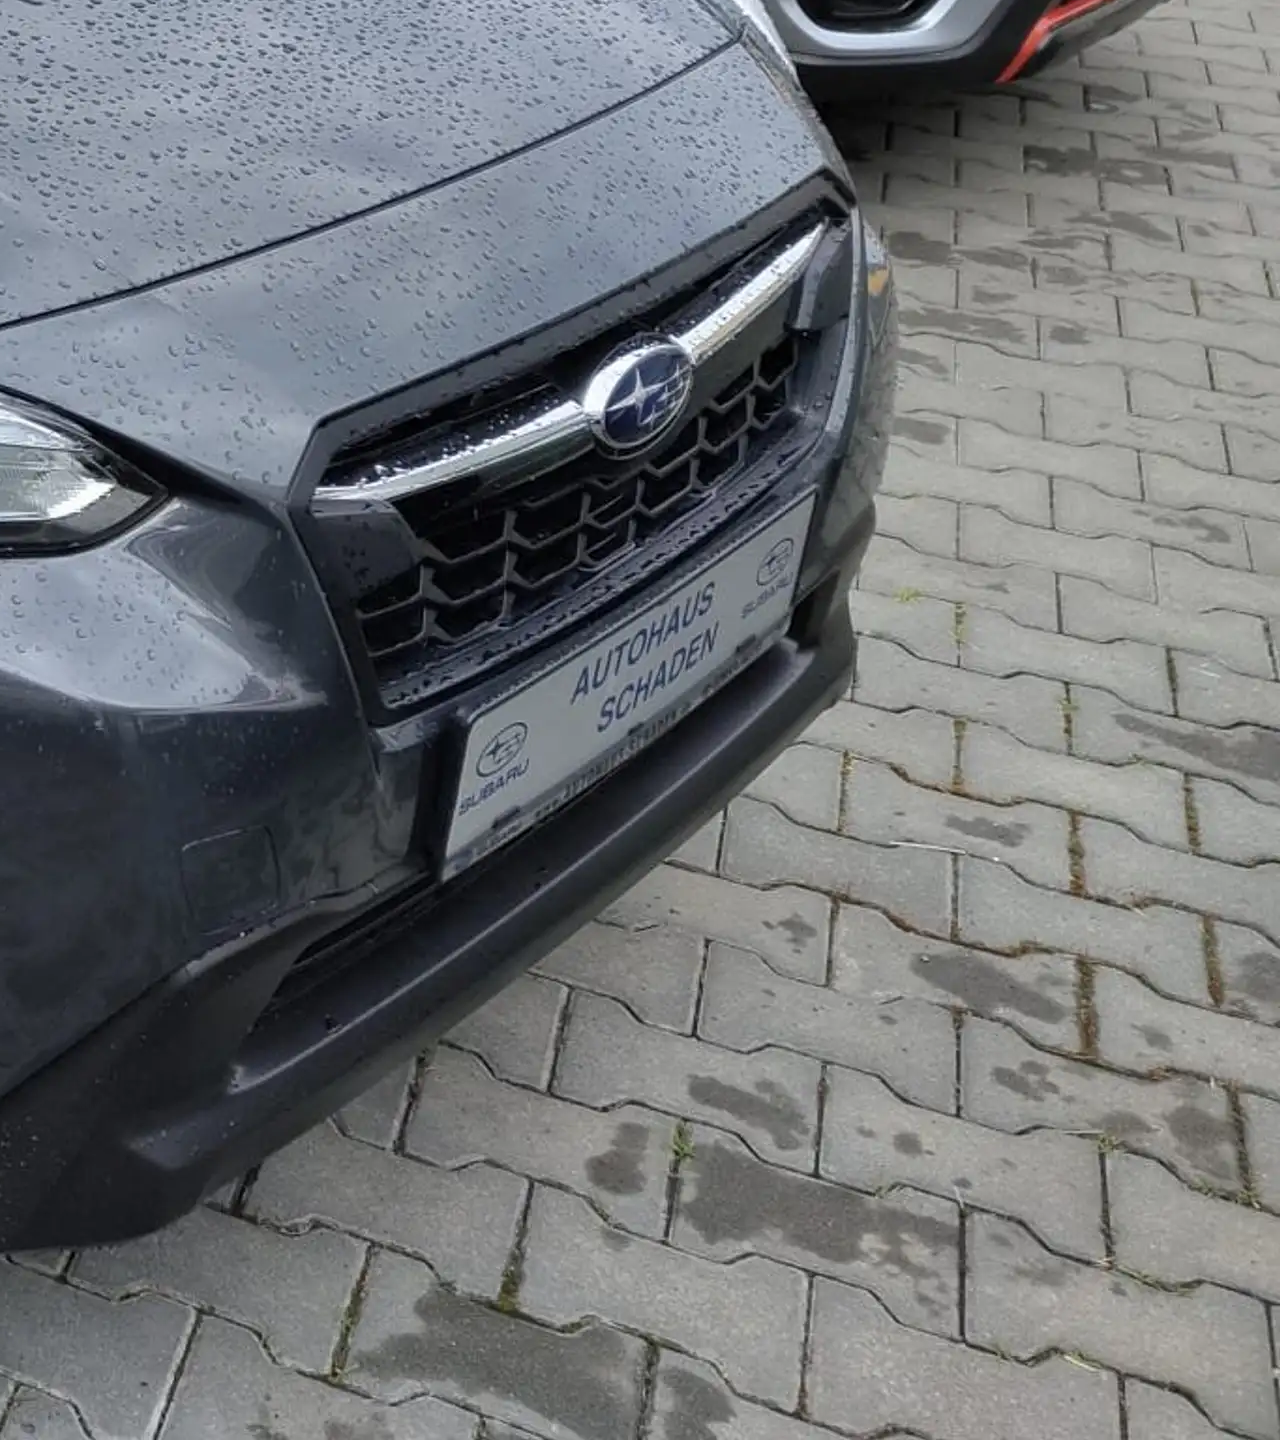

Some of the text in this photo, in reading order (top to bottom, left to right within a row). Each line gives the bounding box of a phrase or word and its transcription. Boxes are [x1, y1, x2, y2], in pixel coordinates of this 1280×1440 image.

[570, 581, 716, 706] AUTOHAUS
[596, 620, 720, 733] SCHADEN
[458, 758, 530, 817] SUBARU
